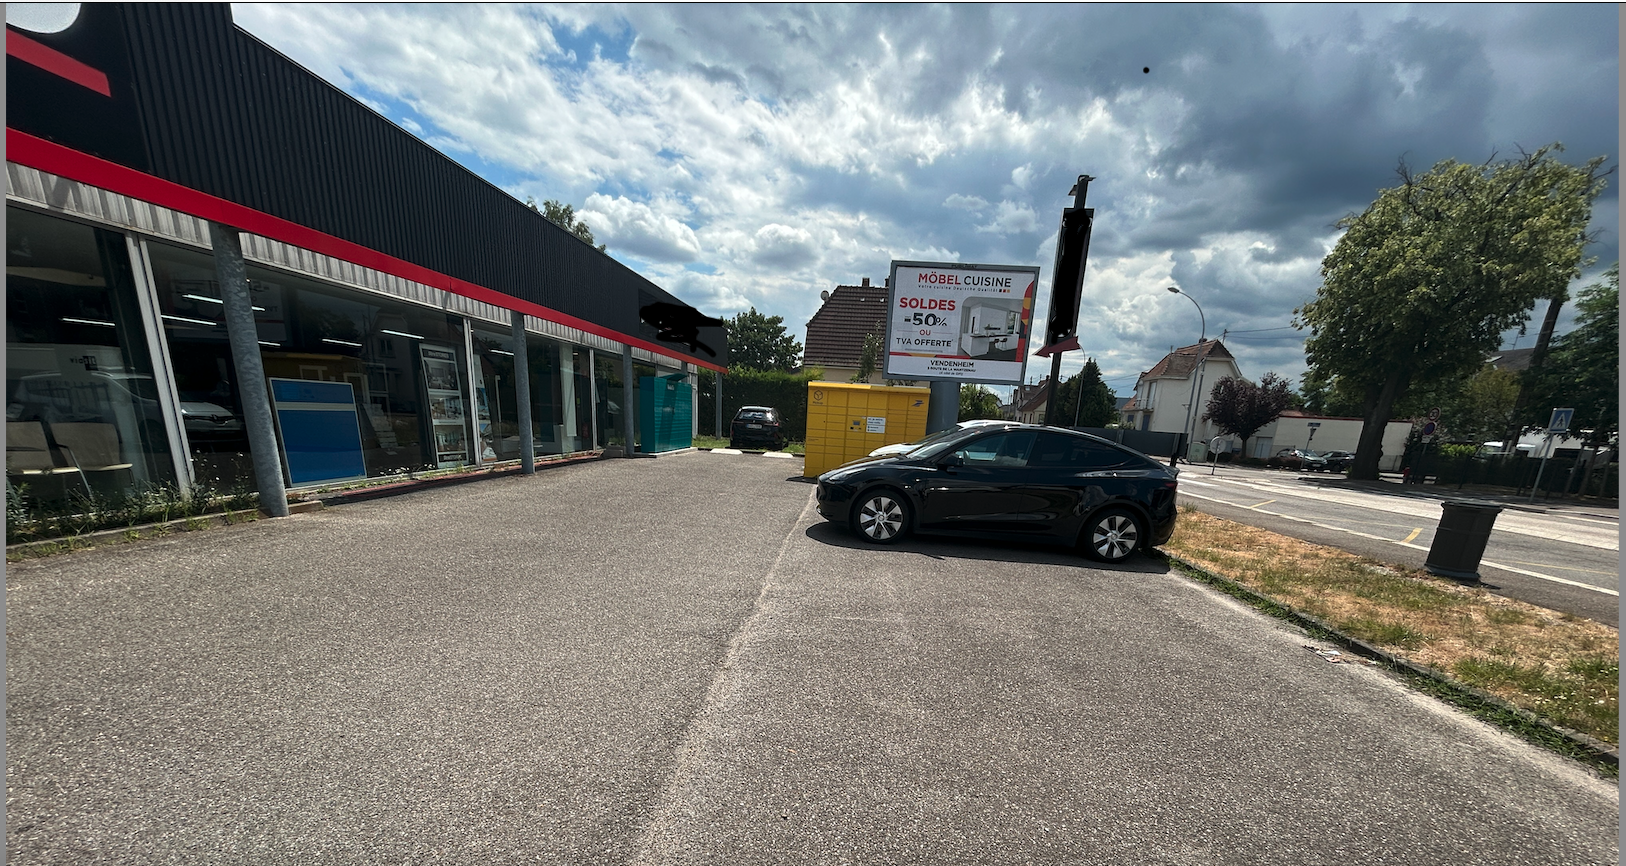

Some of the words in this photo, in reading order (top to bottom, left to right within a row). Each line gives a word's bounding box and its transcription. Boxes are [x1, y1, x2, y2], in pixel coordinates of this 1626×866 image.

[918, 271, 961, 285] MÖBEL
[964, 275, 1012, 288] CUISINE
[899, 297, 956, 311] SOLDES
[896, 337, 912, 345] TVA
[930, 360, 975, 368] VENDENHEIM
